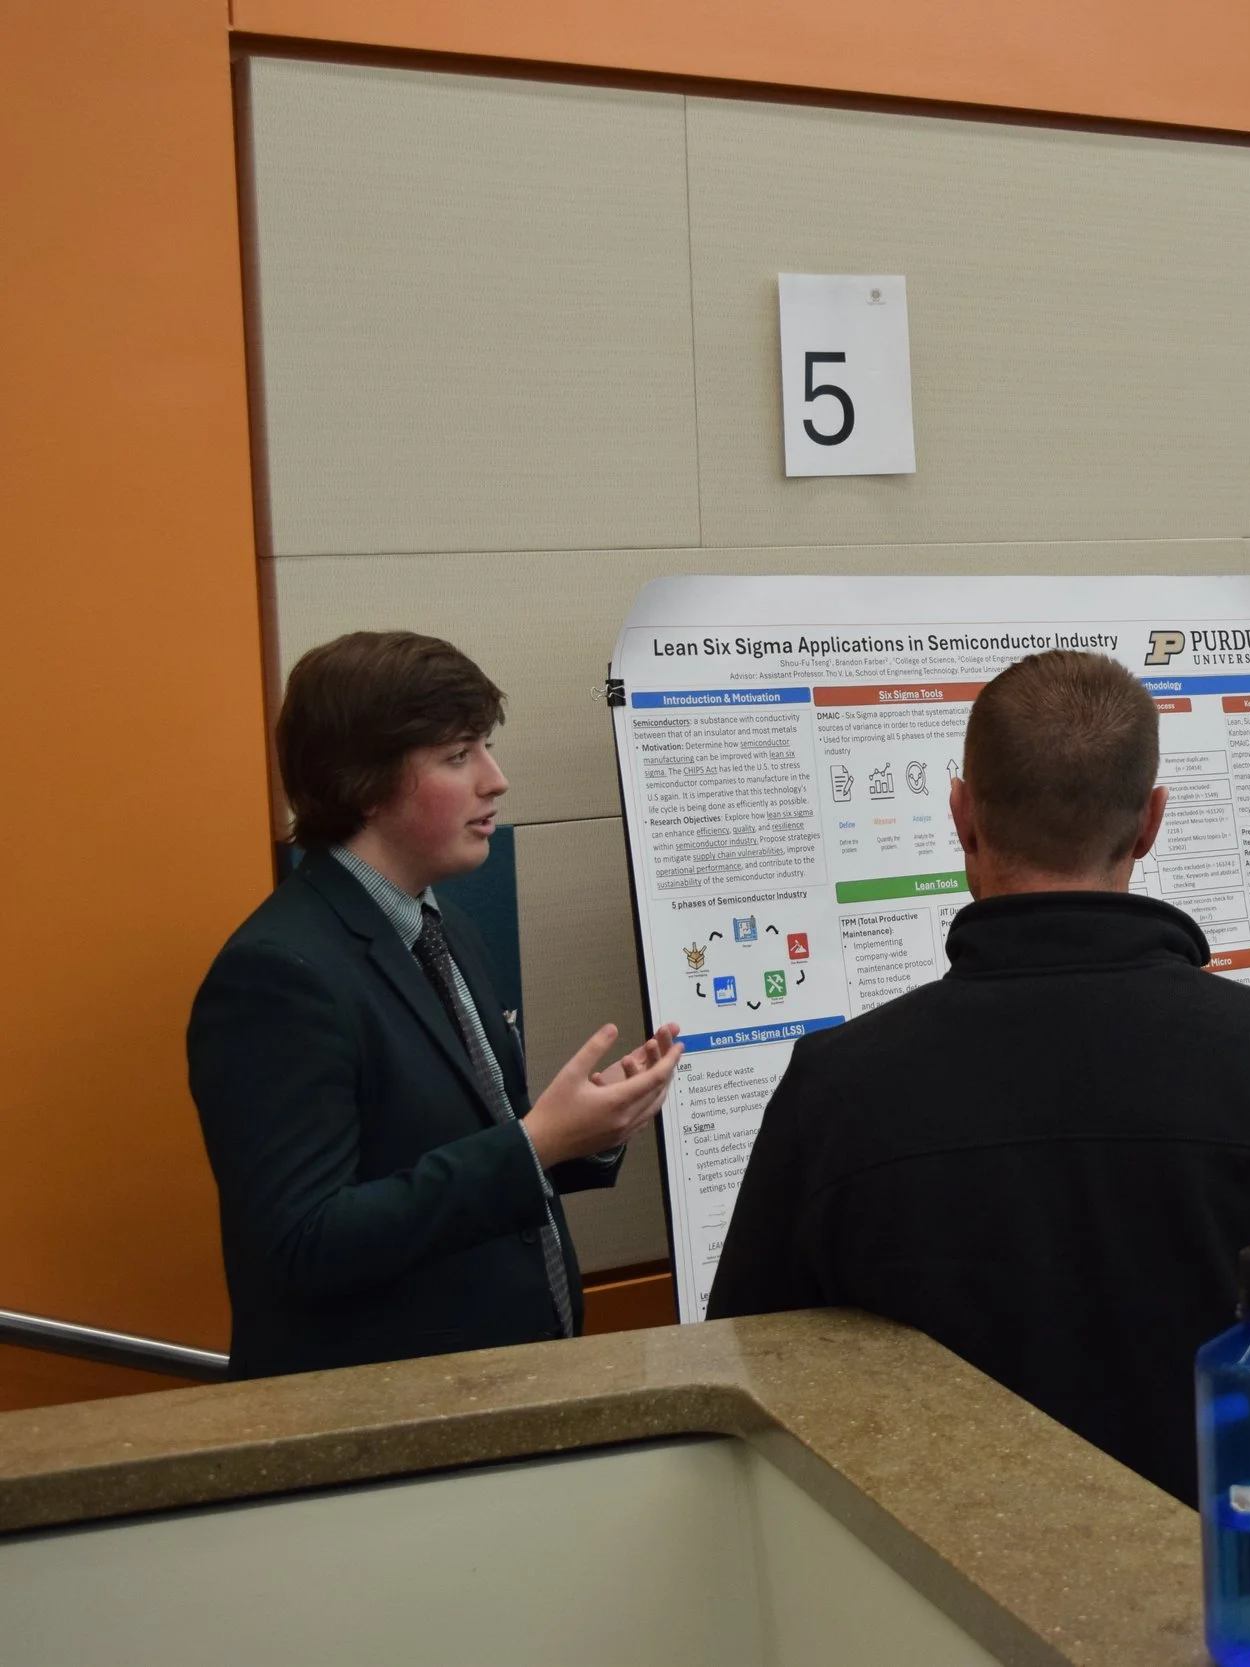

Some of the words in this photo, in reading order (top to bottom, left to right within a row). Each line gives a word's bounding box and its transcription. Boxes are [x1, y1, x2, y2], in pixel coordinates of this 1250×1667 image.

[803, 351, 855, 446] 5
[654, 639, 697, 656] Lean
[703, 639, 730, 655] Six
[735, 638, 792, 659] Sigma
[799, 636, 903, 658] Applications
[908, 636, 923, 652] in
[928, 634, 1052, 651] Semiconductor
[1052, 632, 1117, 654] Industry
[663, 694, 721, 704] Introduction
[724, 694, 730, 703] &
[732, 693, 780, 702] Motivation
[879, 690, 892, 699] Six
[893, 689, 919, 700] Sigma
[920, 688, 942, 698] Tools
[700, 716, 738, 724] substance
[754, 714, 799, 724] conductivity
[817, 712, 840, 720] DMAIC
[856, 711, 877, 720] Sigma
[879, 710, 910, 719] approach
[852, 722, 882, 730] variance
[917, 720, 940, 728] reduce
[940, 719, 966, 727] defects
[634, 731, 666, 739] between
[667, 730, 683, 738] that
[704, 728, 735, 736] insulator
[851, 734, 885, 744] improving
[902, 732, 924, 741] phases
[685, 741, 722, 749] Determine
[723, 740, 738, 748] how
[740, 738, 790, 747] semiconductor
[643, 755, 694, 765] manufacturing
[720, 752, 752, 762] improved
[824, 747, 850, 757] industry
[683, 766, 704, 774] CHIPS
[732, 764, 742, 772] led
[650, 817, 681, 826] Research
[724, 813, 749, 823] Explore
[750, 812, 765, 820] how
[766, 811, 781, 819] lean
[782, 810, 792, 818] six
[792, 809, 813, 819] sigma
[653, 843, 673, 851] within
[675, 839, 728, 849] semiconductor
[759, 835, 786, 845] Propose
[787, 833, 819, 843] strategies
[915, 880, 934, 891] Lean
[936, 878, 957, 889] Tools
[672, 901, 676, 909] 5
[678, 899, 706, 910] phases
[707, 898, 715, 906] of
[716, 893, 774, 905] Semiconductor
[776, 890, 806, 901] Industry
[841, 918, 856, 927] TPM
[857, 916, 877, 927] (Total
[878, 912, 917, 923] Productive
[853, 938, 902, 951] Implementing
[855, 949, 907, 963] company-wide
[1211, 957, 1231, 966] Micro
[857, 961, 903, 973] maintenance
[904, 958, 934, 970] protocol
[858, 976, 876, 986] Aims
[877, 976, 884, 984] to
[885, 973, 910, 983] reduce
[710, 1033, 733, 1046] Lean
[735, 1031, 749, 1043] Six
[751, 1027, 780, 1043] Sigma
[782, 1024, 804, 1038] (LSS)
[677, 1062, 691, 1070] Lean
[706, 1068, 732, 1079] Reduce
[734, 1065, 754, 1075] waste
[688, 1082, 721, 1094] Measures
[724, 1076, 768, 1089] effectiveness
[770, 1074, 776, 1082] of
[690, 1097, 706, 1107] Aims
[707, 1096, 715, 1104] to
[716, 1092, 739, 1103] lessen
[741, 1087, 768, 1100] wastage
[683, 1124, 692, 1132] Six
[694, 1121, 714, 1132] Sigma
